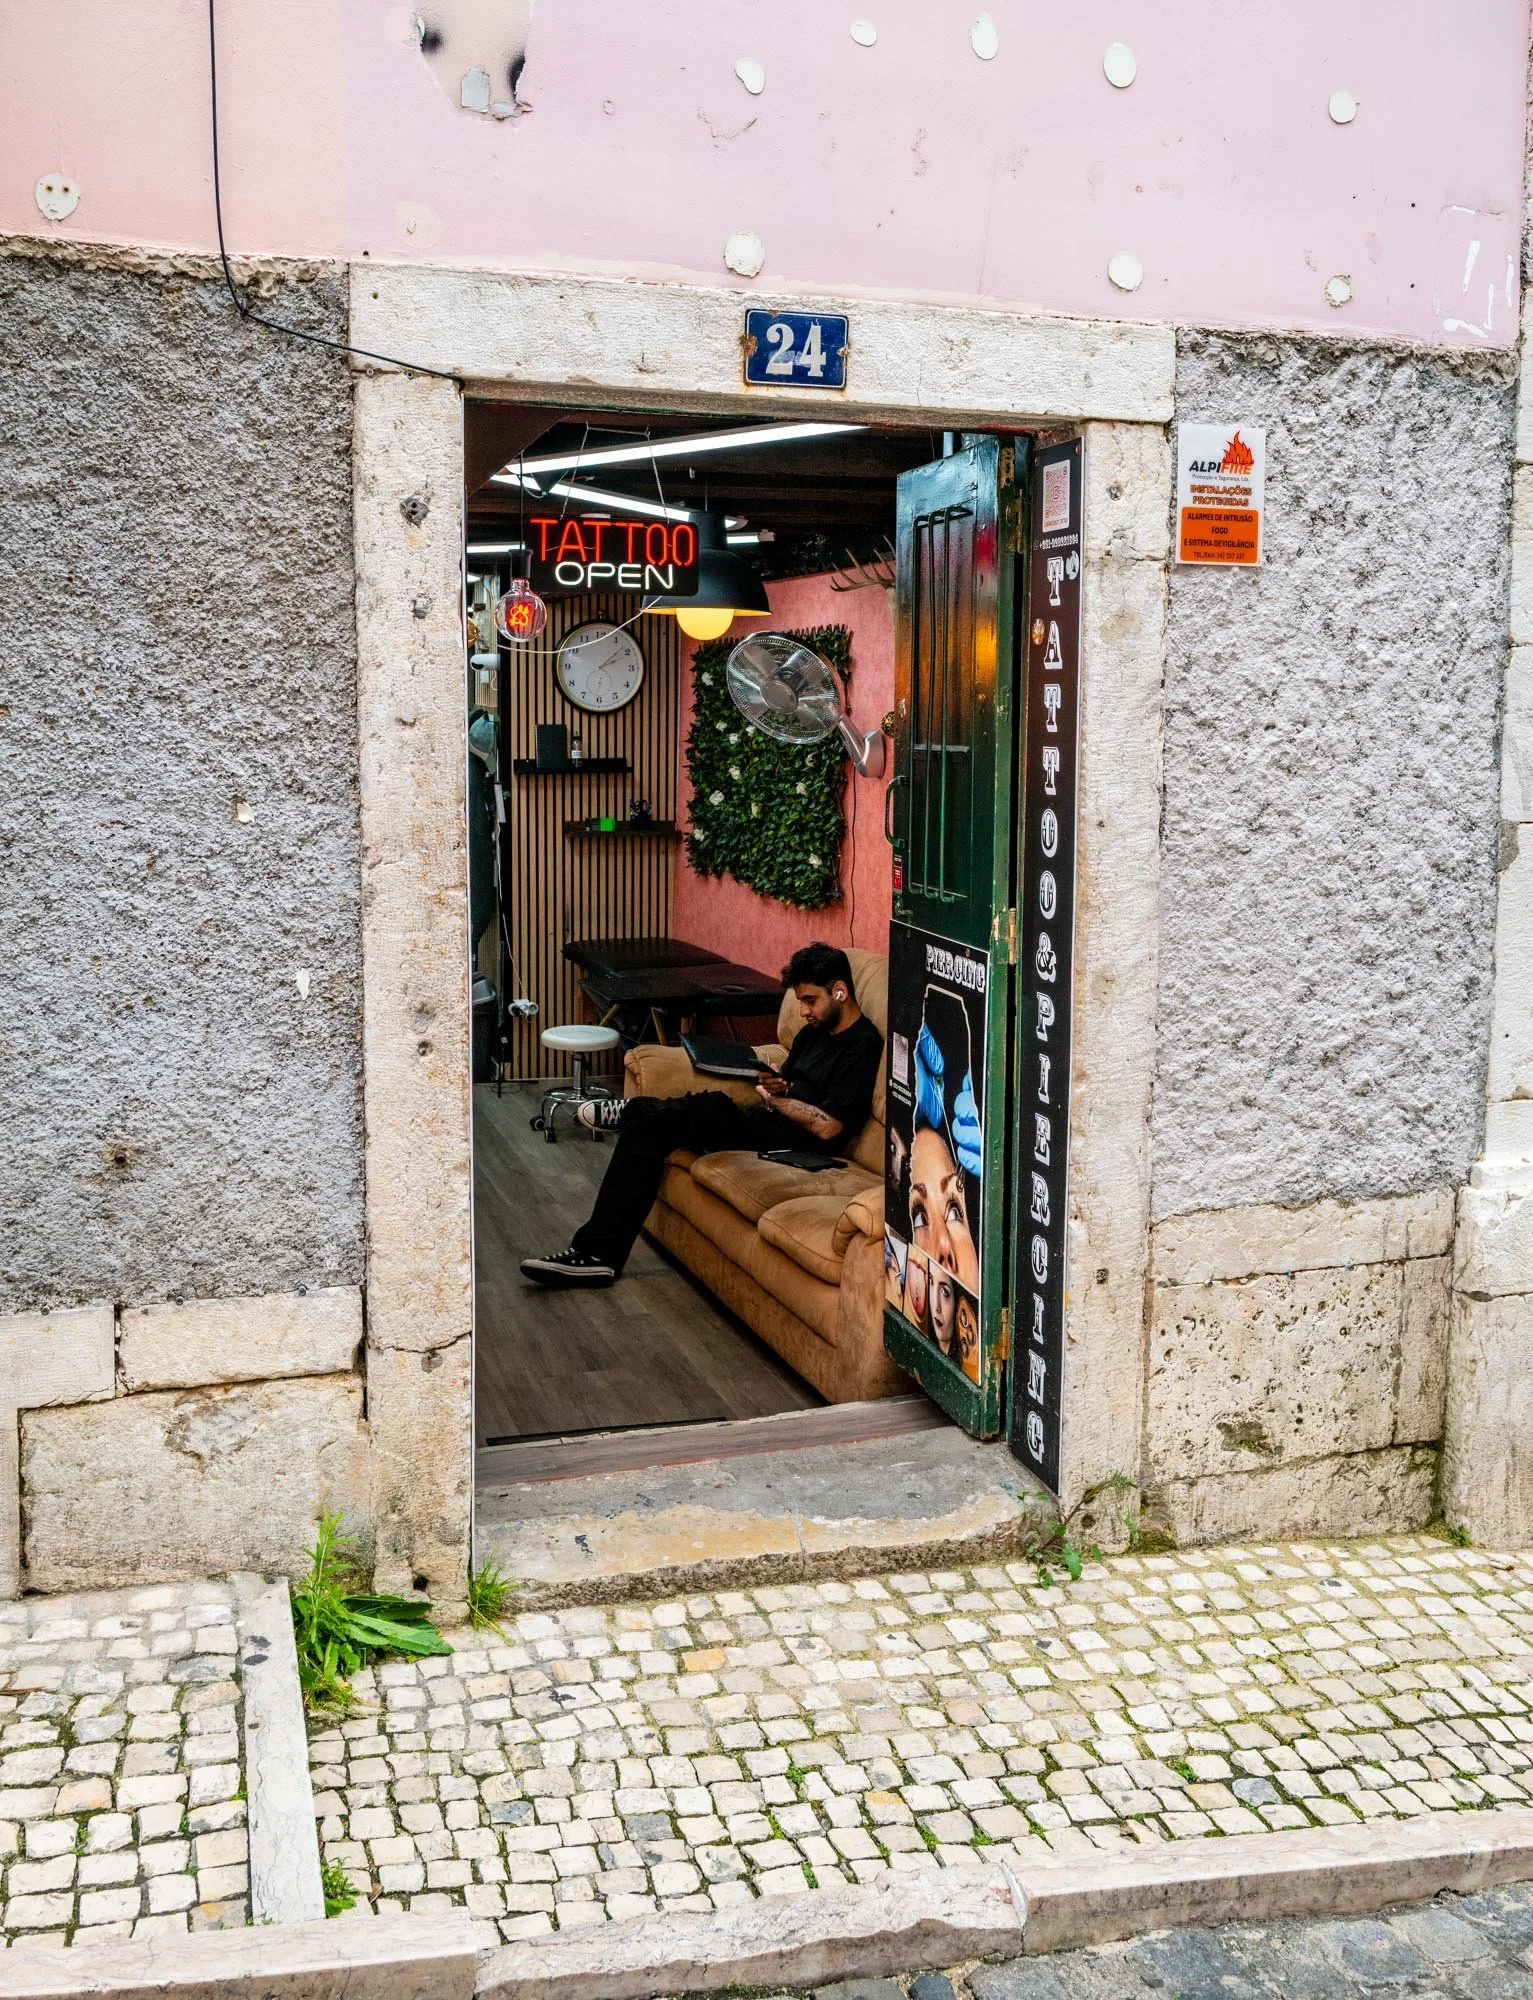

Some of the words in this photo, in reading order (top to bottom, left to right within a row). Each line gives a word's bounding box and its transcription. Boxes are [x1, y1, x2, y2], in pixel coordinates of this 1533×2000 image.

[766, 322, 827, 378] 24
[1189, 460, 1253, 475] ALPIFIRE
[1190, 484, 1253, 496] INSTALAÇÕES
[1192, 495, 1250, 507] PROTEGIDAS
[1187, 512, 1214, 521] ALARMES
[1214, 513, 1223, 521] DE
[1224, 514, 1253, 523] INTRUSÃO
[1211, 526, 1229, 535] FOGO
[529, 517, 695, 567] TATTOO
[1189, 538, 1213, 547] SISTEMA
[554, 560, 674, 590] OPEN
[624, 648, 631, 656] 2
[564, 663, 571, 671] 9
[628, 664, 635, 672] 3
[581, 691, 587, 699] 7
[596, 696, 602, 704] 6
[612, 692, 618, 700] 5
[925, 943, 986, 994] PIERCING
